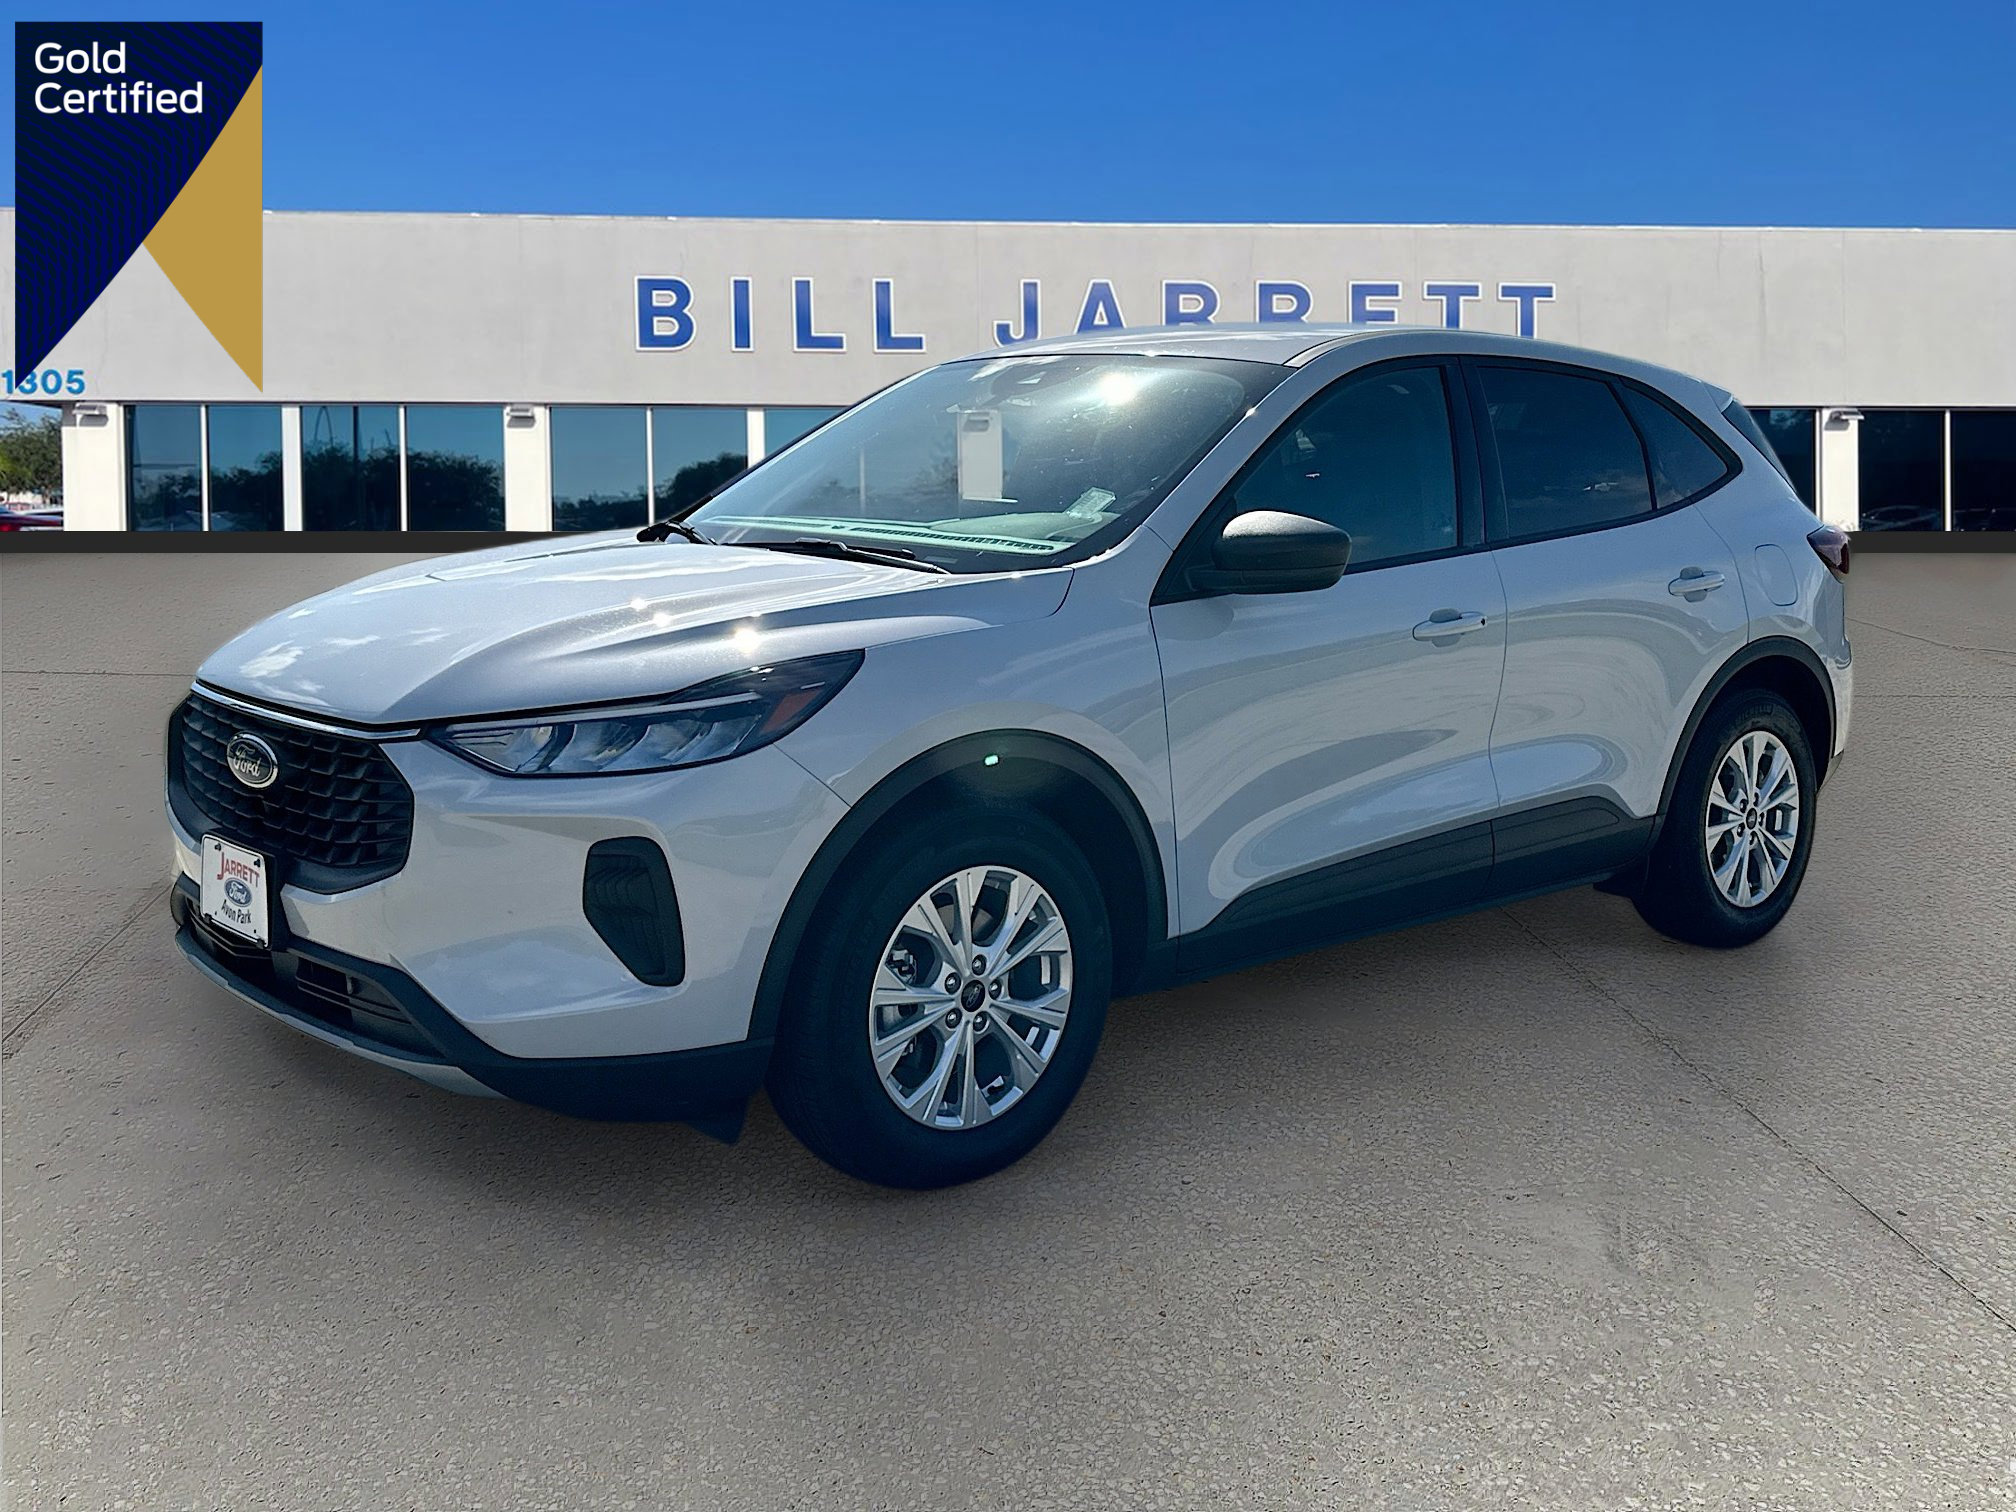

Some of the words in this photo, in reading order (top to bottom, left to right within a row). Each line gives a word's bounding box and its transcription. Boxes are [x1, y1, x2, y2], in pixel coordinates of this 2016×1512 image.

[634, 275, 926, 354] BILL
[993, 279, 1556, 348] JARRETT
[1, 368, 86, 395] 1305
[217, 852, 260, 888] JARRETT
[221, 899, 236, 920] Avon
[236, 908, 252, 925] Park
